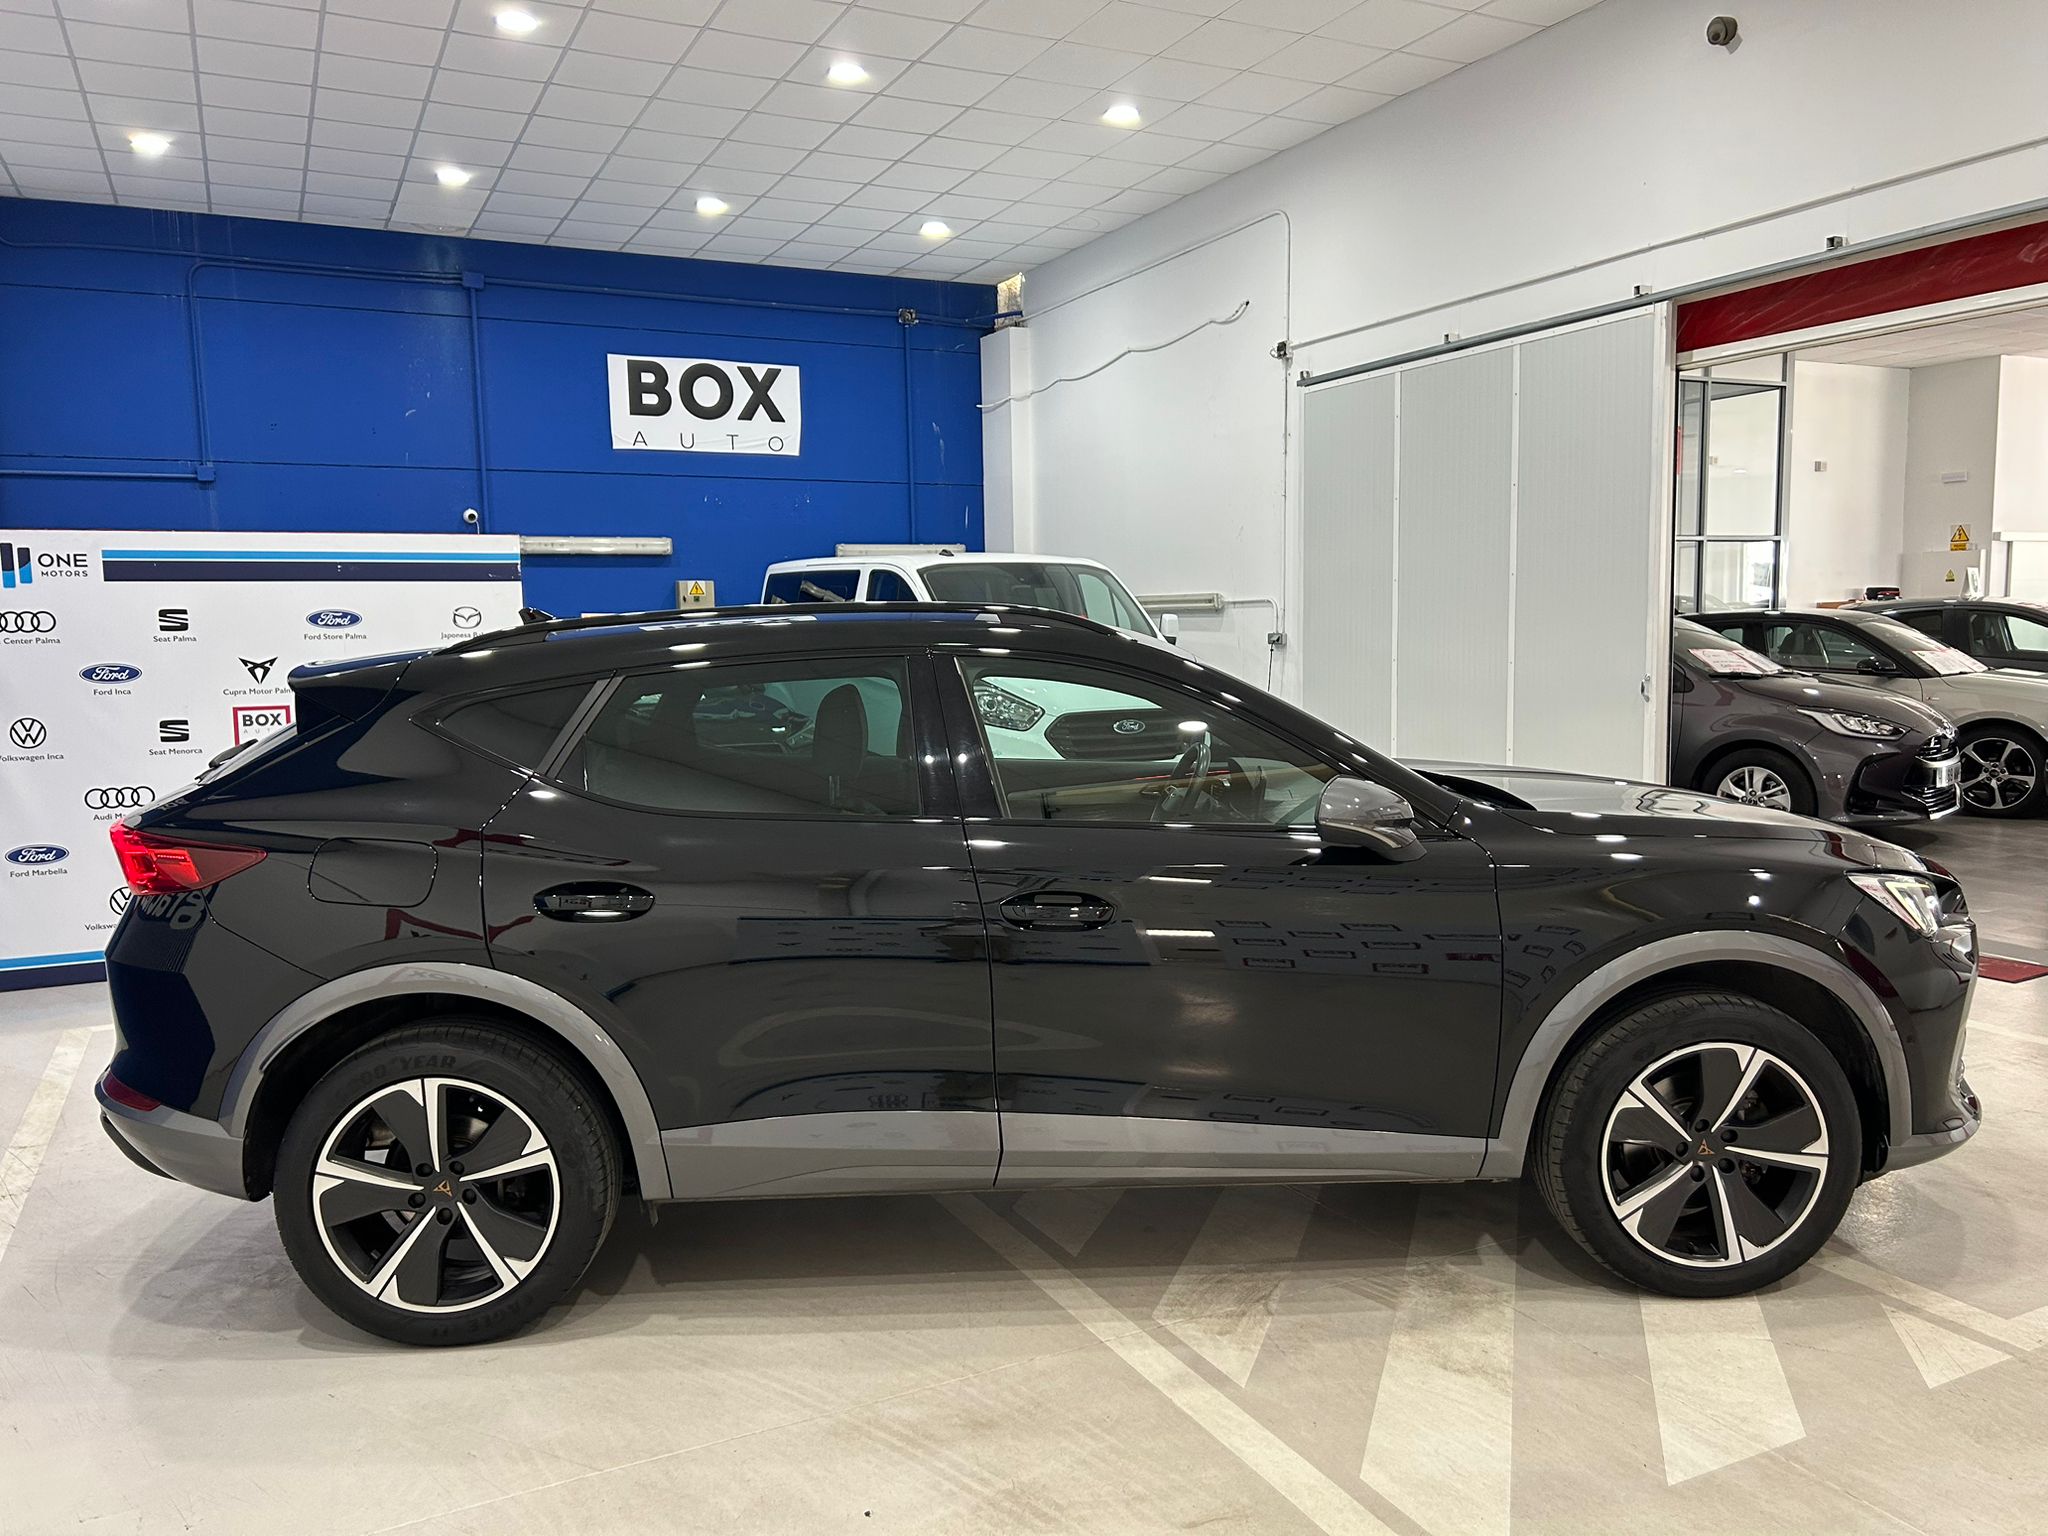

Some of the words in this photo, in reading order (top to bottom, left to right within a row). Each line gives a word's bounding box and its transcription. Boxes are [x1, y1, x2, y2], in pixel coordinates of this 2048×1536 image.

[627, 359, 786, 423] BOX
[633, 430, 784, 452] AUTO
[37, 553, 88, 568] ONE
[345, 632, 367, 640] Palma
[3, 637, 34, 645] Center
[93, 688, 113, 696] Ford
[114, 687, 132, 695] Inca
[222, 688, 247, 696] Cupra
[248, 687, 273, 695] Motor
[242, 713, 282, 727] BOX
[148, 748, 167, 756] Seat
[93, 812, 113, 821] Audi
[10, 870, 30, 878] Ford
[32, 868, 68, 876] Marbella
[84, 923, 117, 931] Volksw
